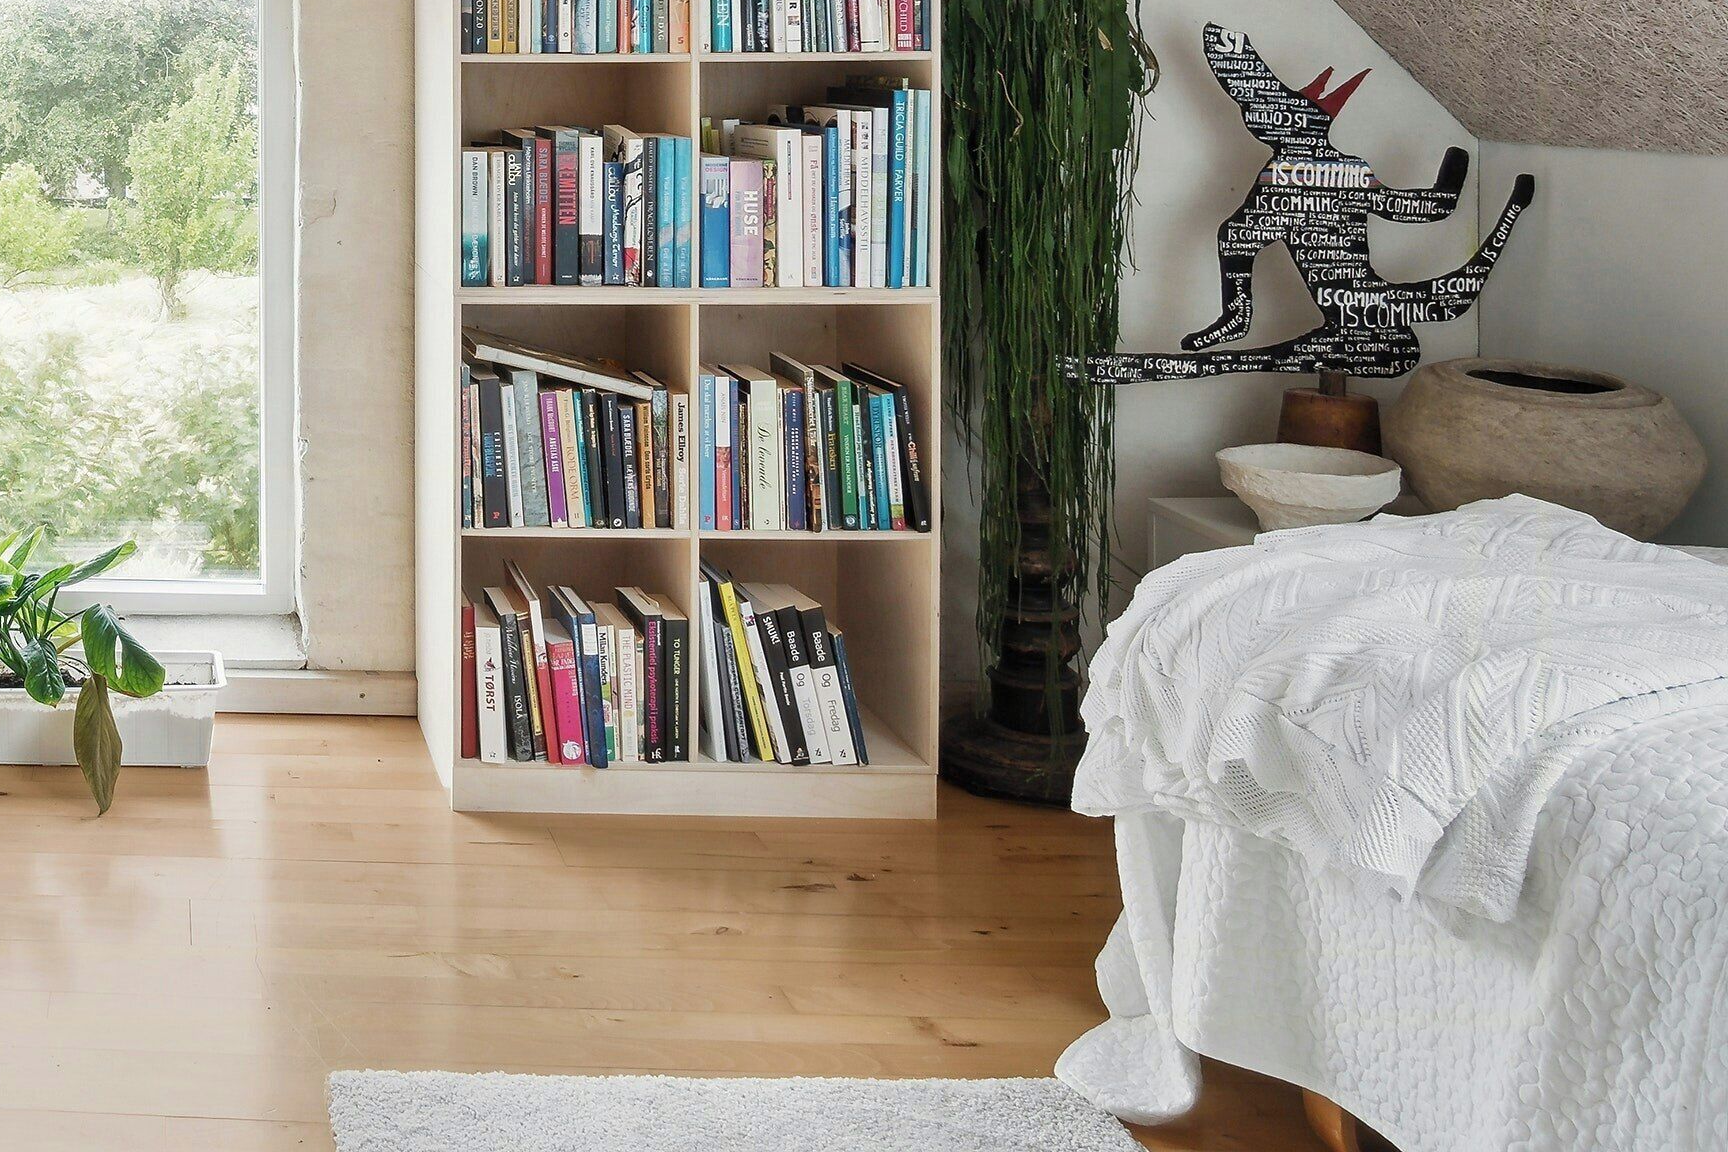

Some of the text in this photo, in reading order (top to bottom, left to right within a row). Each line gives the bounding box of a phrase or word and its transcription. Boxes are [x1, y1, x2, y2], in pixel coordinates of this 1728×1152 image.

[1215, 29, 1244, 54] IS
[539, 148, 547, 169] SARA
[895, 102, 904, 202] TRICIA GUILD FARVER
[1272, 162, 1289, 185] IS
[744, 191, 758, 235] HUSE
[1256, 195, 1339, 212] IS COMMING
[1309, 269, 1318, 281] IS
[1432, 281, 1445, 294] IS
[1317, 287, 1331, 306] IS
[1340, 304, 1359, 327] IS
[1364, 302, 1437, 328] COMING
[677, 435, 685, 462] Ellroy
[674, 639, 680, 647] TO
[762, 616, 780, 644] SMUK!
[787, 631, 800, 661] Baade
[812, 631, 826, 661] Baade
[600, 655, 608, 685] Kundera
[624, 654, 632, 686] PLASTIC
[796, 673, 806, 687] Og
[485, 675, 495, 711] TØRST
[624, 689, 633, 709] MIND
[822, 674, 841, 732] Og Fredag
